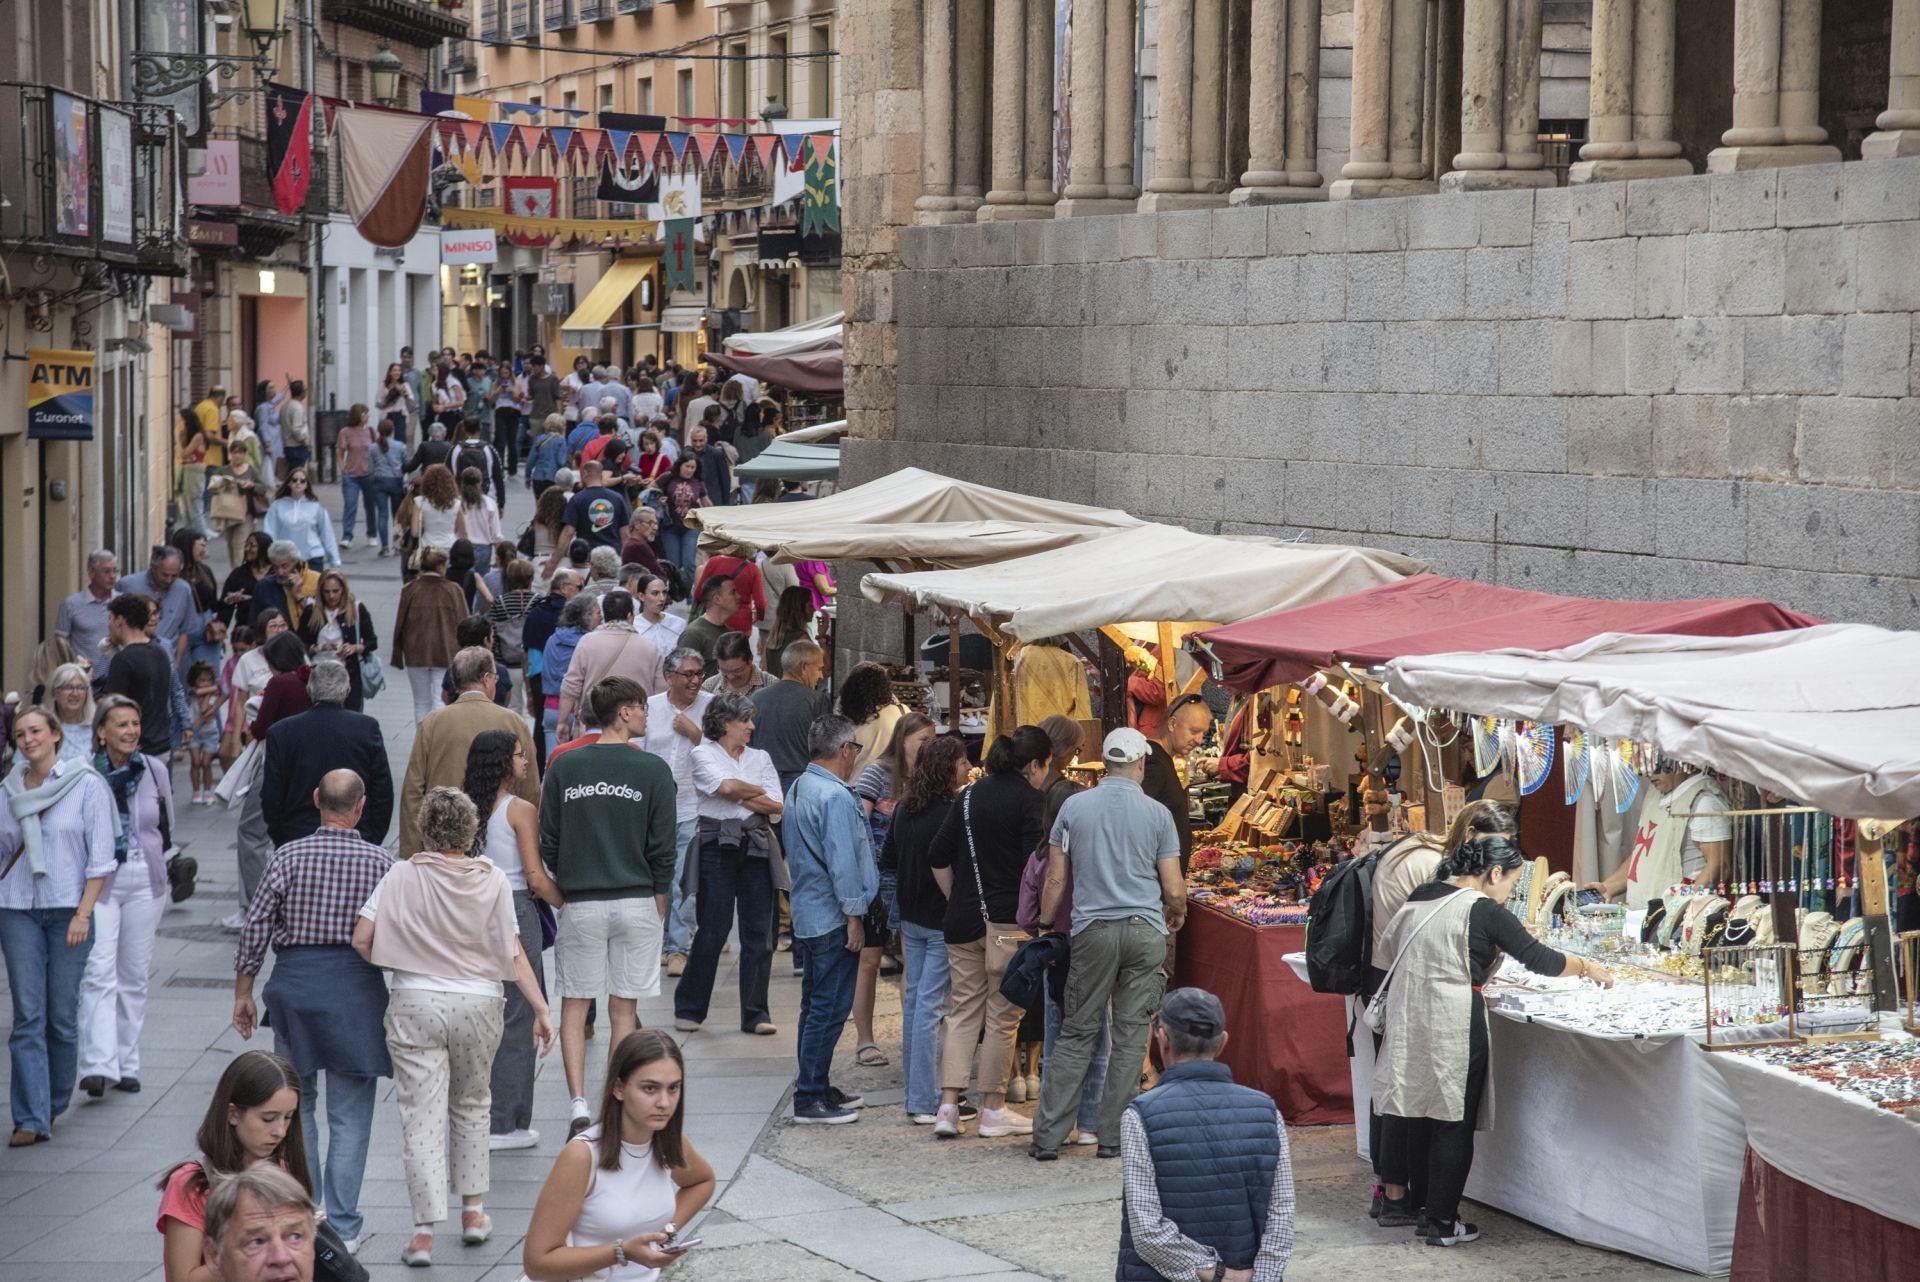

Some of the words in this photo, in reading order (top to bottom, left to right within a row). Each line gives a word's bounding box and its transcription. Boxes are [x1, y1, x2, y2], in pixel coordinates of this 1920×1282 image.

[445, 241, 494, 253] MINISO
[32, 364, 91, 386] ATM
[35, 412, 84, 424] Euronet
[564, 781, 642, 802] FakeGods®
